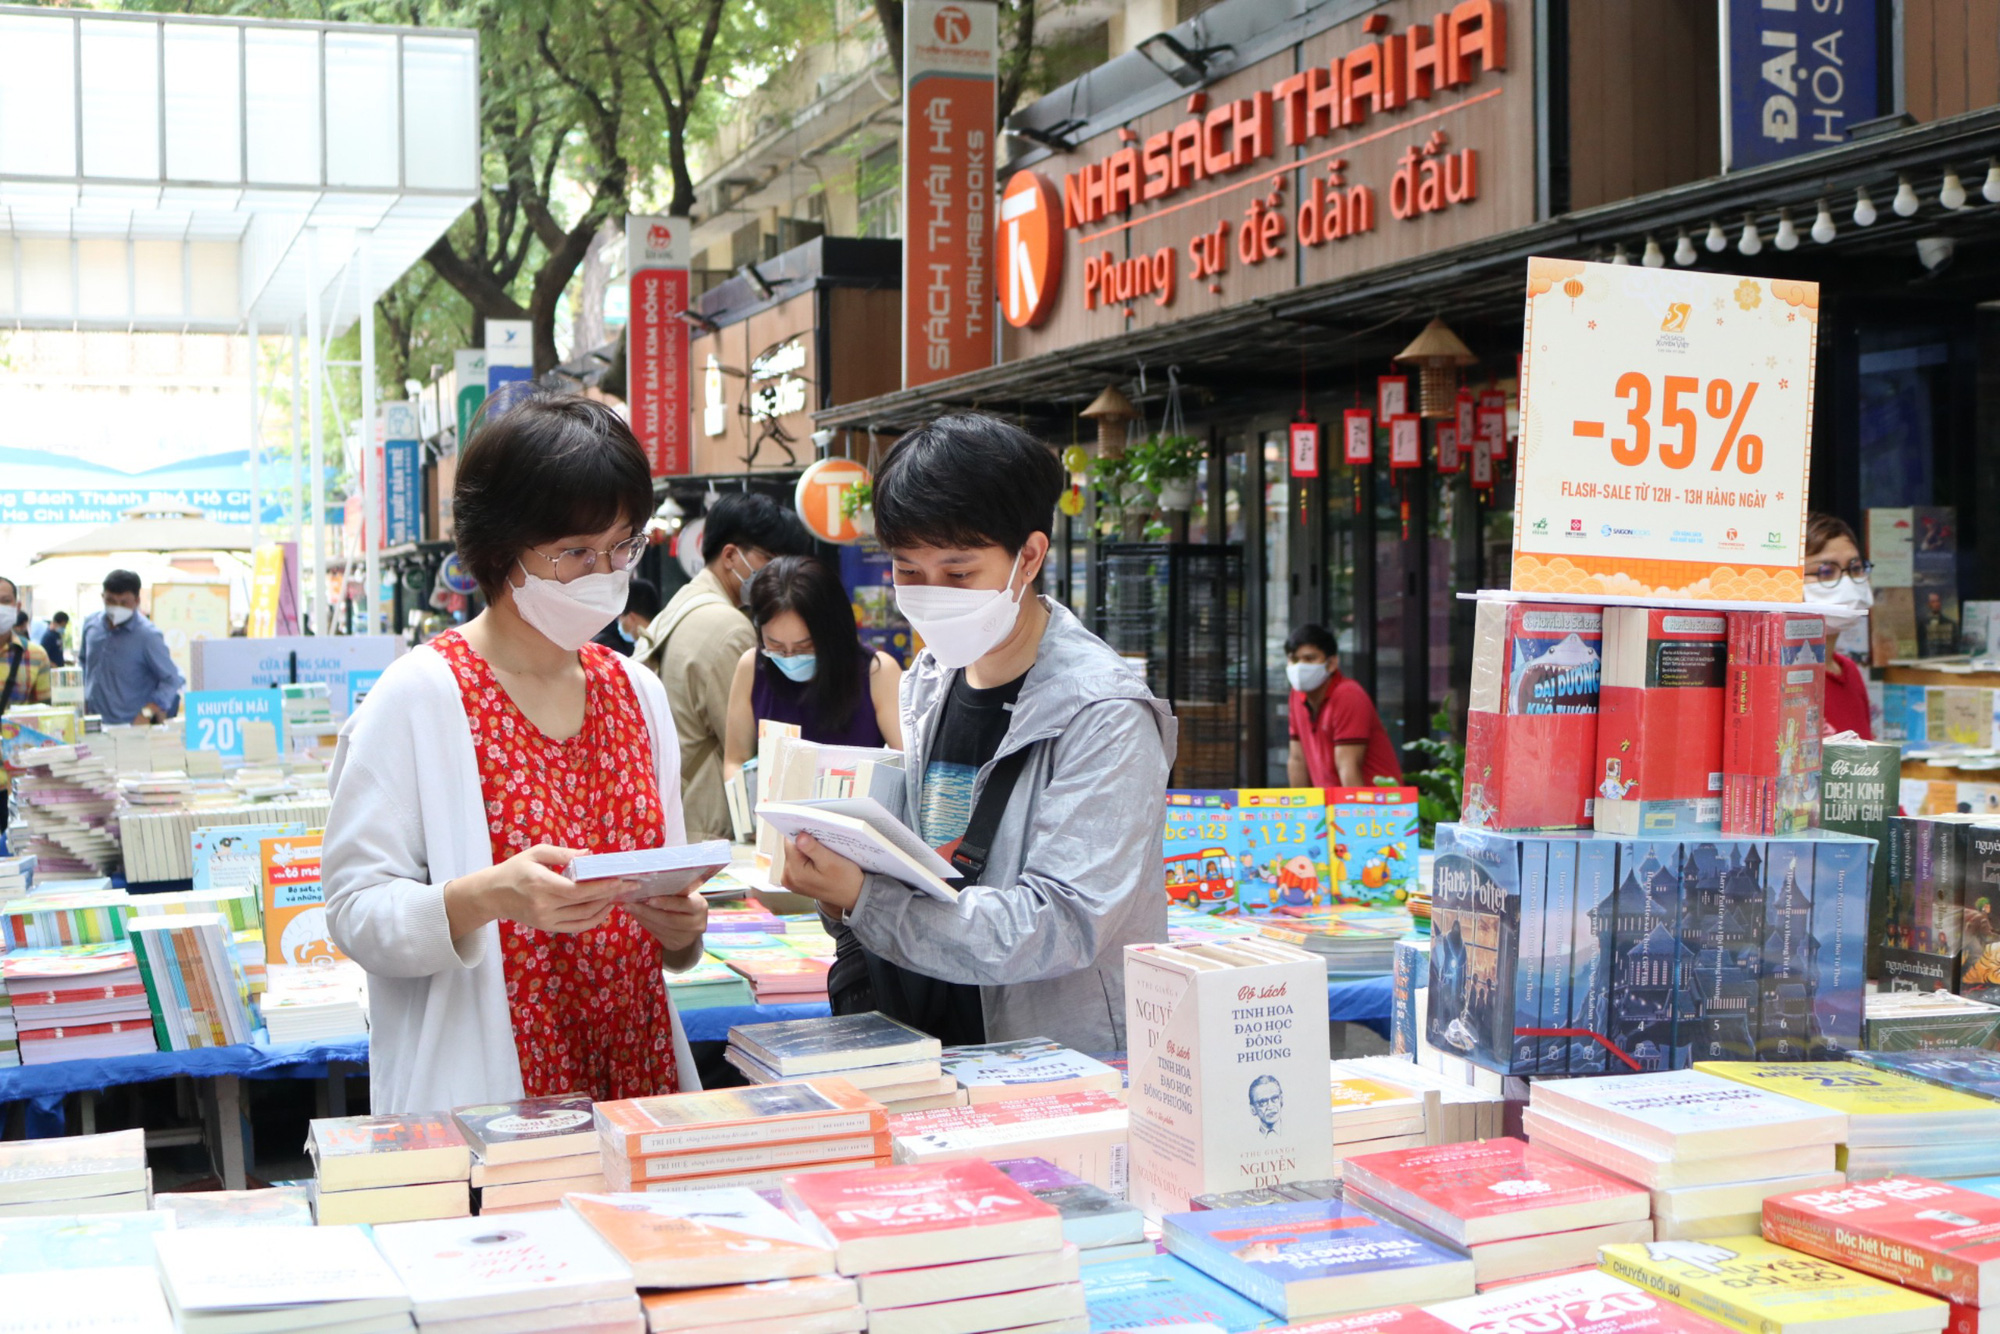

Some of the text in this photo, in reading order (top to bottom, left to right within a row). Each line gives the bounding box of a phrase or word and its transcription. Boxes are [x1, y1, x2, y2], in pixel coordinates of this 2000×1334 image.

[1762, 30, 1807, 143] ĐẠI
[1812, 30, 1843, 142] HOA
[1064, 14, 1405, 228] NHÀ SÁCH THÁI
[924, 97, 952, 370] SÁCH THÁI HÀ
[966, 130, 984, 338] THAIHABOOKS
[1084, 130, 1477, 317] Phụng sự để dẫn đầu
[642, 278, 658, 324] ĐỒNG
[645, 326, 658, 356] KIM
[643, 359, 658, 390] BẢN
[664, 280, 678, 471] KIM DONG PUBLISHING HOUSE
[642, 393, 658, 433] XUẤT
[1573, 371, 1764, 475] -35%
[1561, 481, 1767, 508] FLASH-SALE TỪ 12H 13H HÀNG NGÀY
[1534, 616, 1570, 629] Horrible
[1535, 678, 1555, 702] ĐẠI
[197, 697, 268, 715] KHUYẾN MÃI
[1831, 759, 1880, 778] Bộ sách
[1825, 782, 1884, 803] DỊCH KINH
[1825, 799, 1883, 825] LUẬN GIẢI
[1165, 823, 1187, 840] bc
[1261, 823, 1306, 845] 1 2 3
[1355, 819, 1395, 837] a b c
[285, 866, 321, 878] tô mà
[1437, 867, 1508, 914] Harry Potter
[1237, 982, 1287, 1003] Bộ sách
[1231, 1004, 1294, 1020] TINH HOA
[1235, 1019, 1292, 1037] ĐẠO HỌC
[1176, 1044, 1191, 1061] sách
[1245, 1034, 1282, 1048] ĐÔNG
[1237, 1048, 1291, 1064] PHƯƠNG
[1158, 1057, 1192, 1080] TINH HOA
[1144, 1083, 1193, 1115] ĐÔNG PHƯƠNG
[1160, 1075, 1192, 1099] ĐẠO HỌC
[1266, 1146, 1292, 1157] GIANG
[1240, 1154, 1296, 1176] NGUYỄN
[1885, 1184, 1954, 1201] tim
[1880, 1239, 1902, 1261] trái
[1904, 1245, 1925, 1270] tim
[1613, 1261, 1681, 1299] CHUYỂN ĐỔI SỐ
